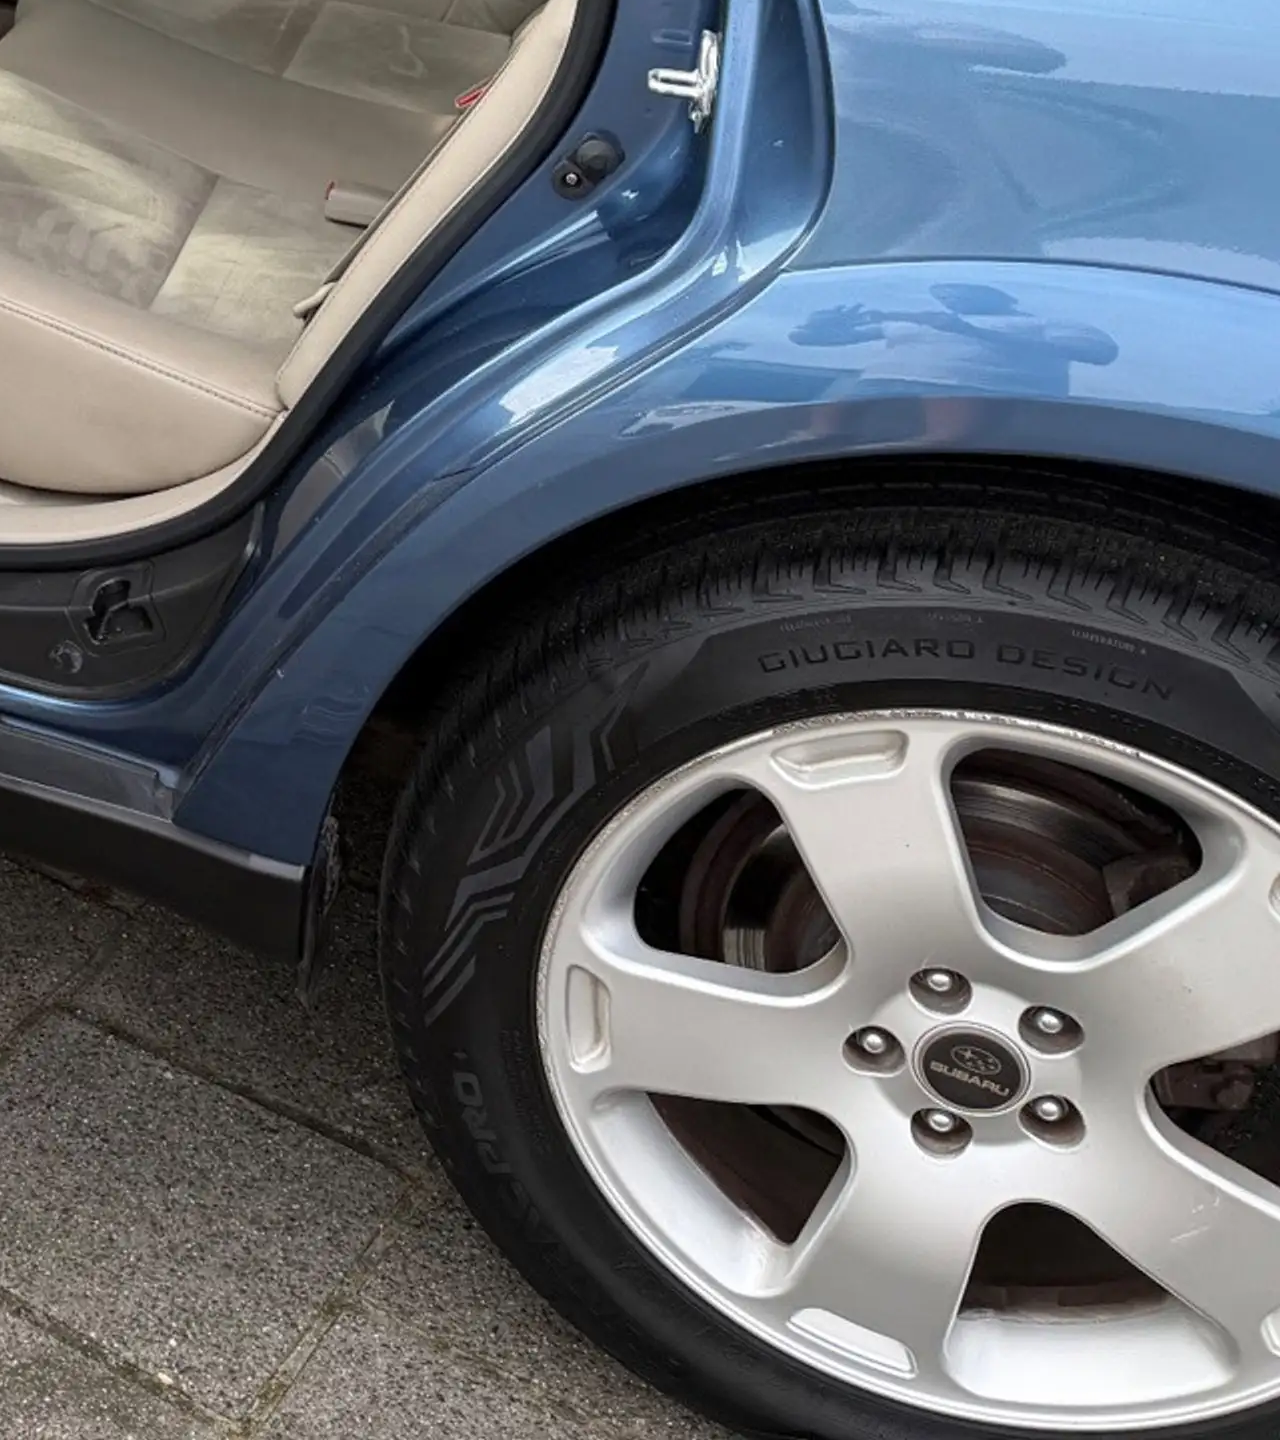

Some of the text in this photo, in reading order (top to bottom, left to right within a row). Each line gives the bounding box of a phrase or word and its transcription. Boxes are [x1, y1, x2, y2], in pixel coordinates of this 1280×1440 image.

[758, 637, 1174, 702] GIUGIARO DESIGN
[930, 1060, 1010, 1097] SUBARU
